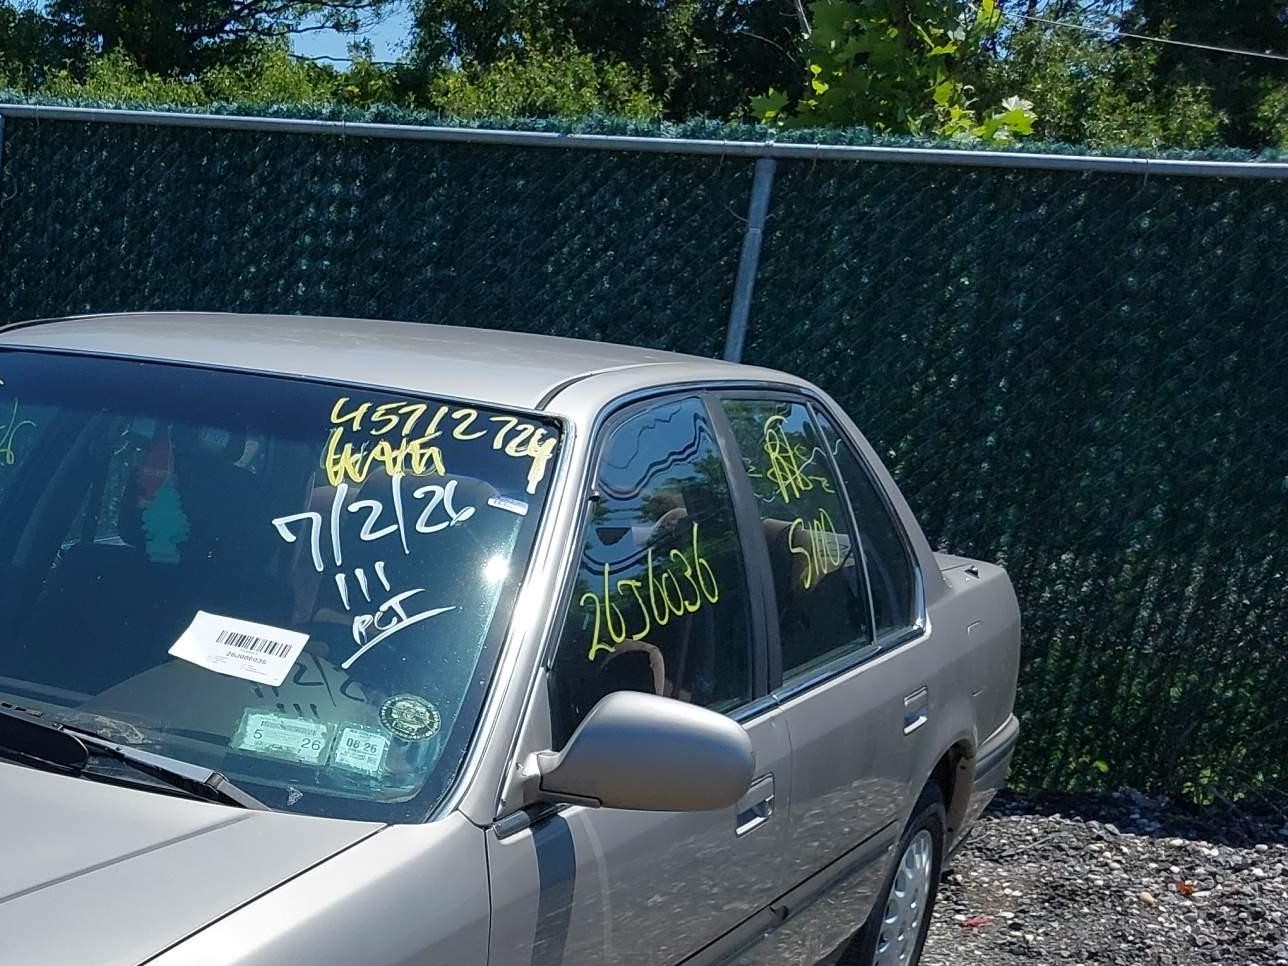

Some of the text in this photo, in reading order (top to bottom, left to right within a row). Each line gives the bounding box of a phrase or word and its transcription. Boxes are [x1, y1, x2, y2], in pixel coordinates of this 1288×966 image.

[330, 397, 557, 494] 45712724
[271, 474, 477, 572] 7/2/26
[579, 521, 720, 662] 26J6036
[253, 728, 265, 740] 5
[300, 737, 321, 751] 26
[346, 737, 378, 754] 08 26
